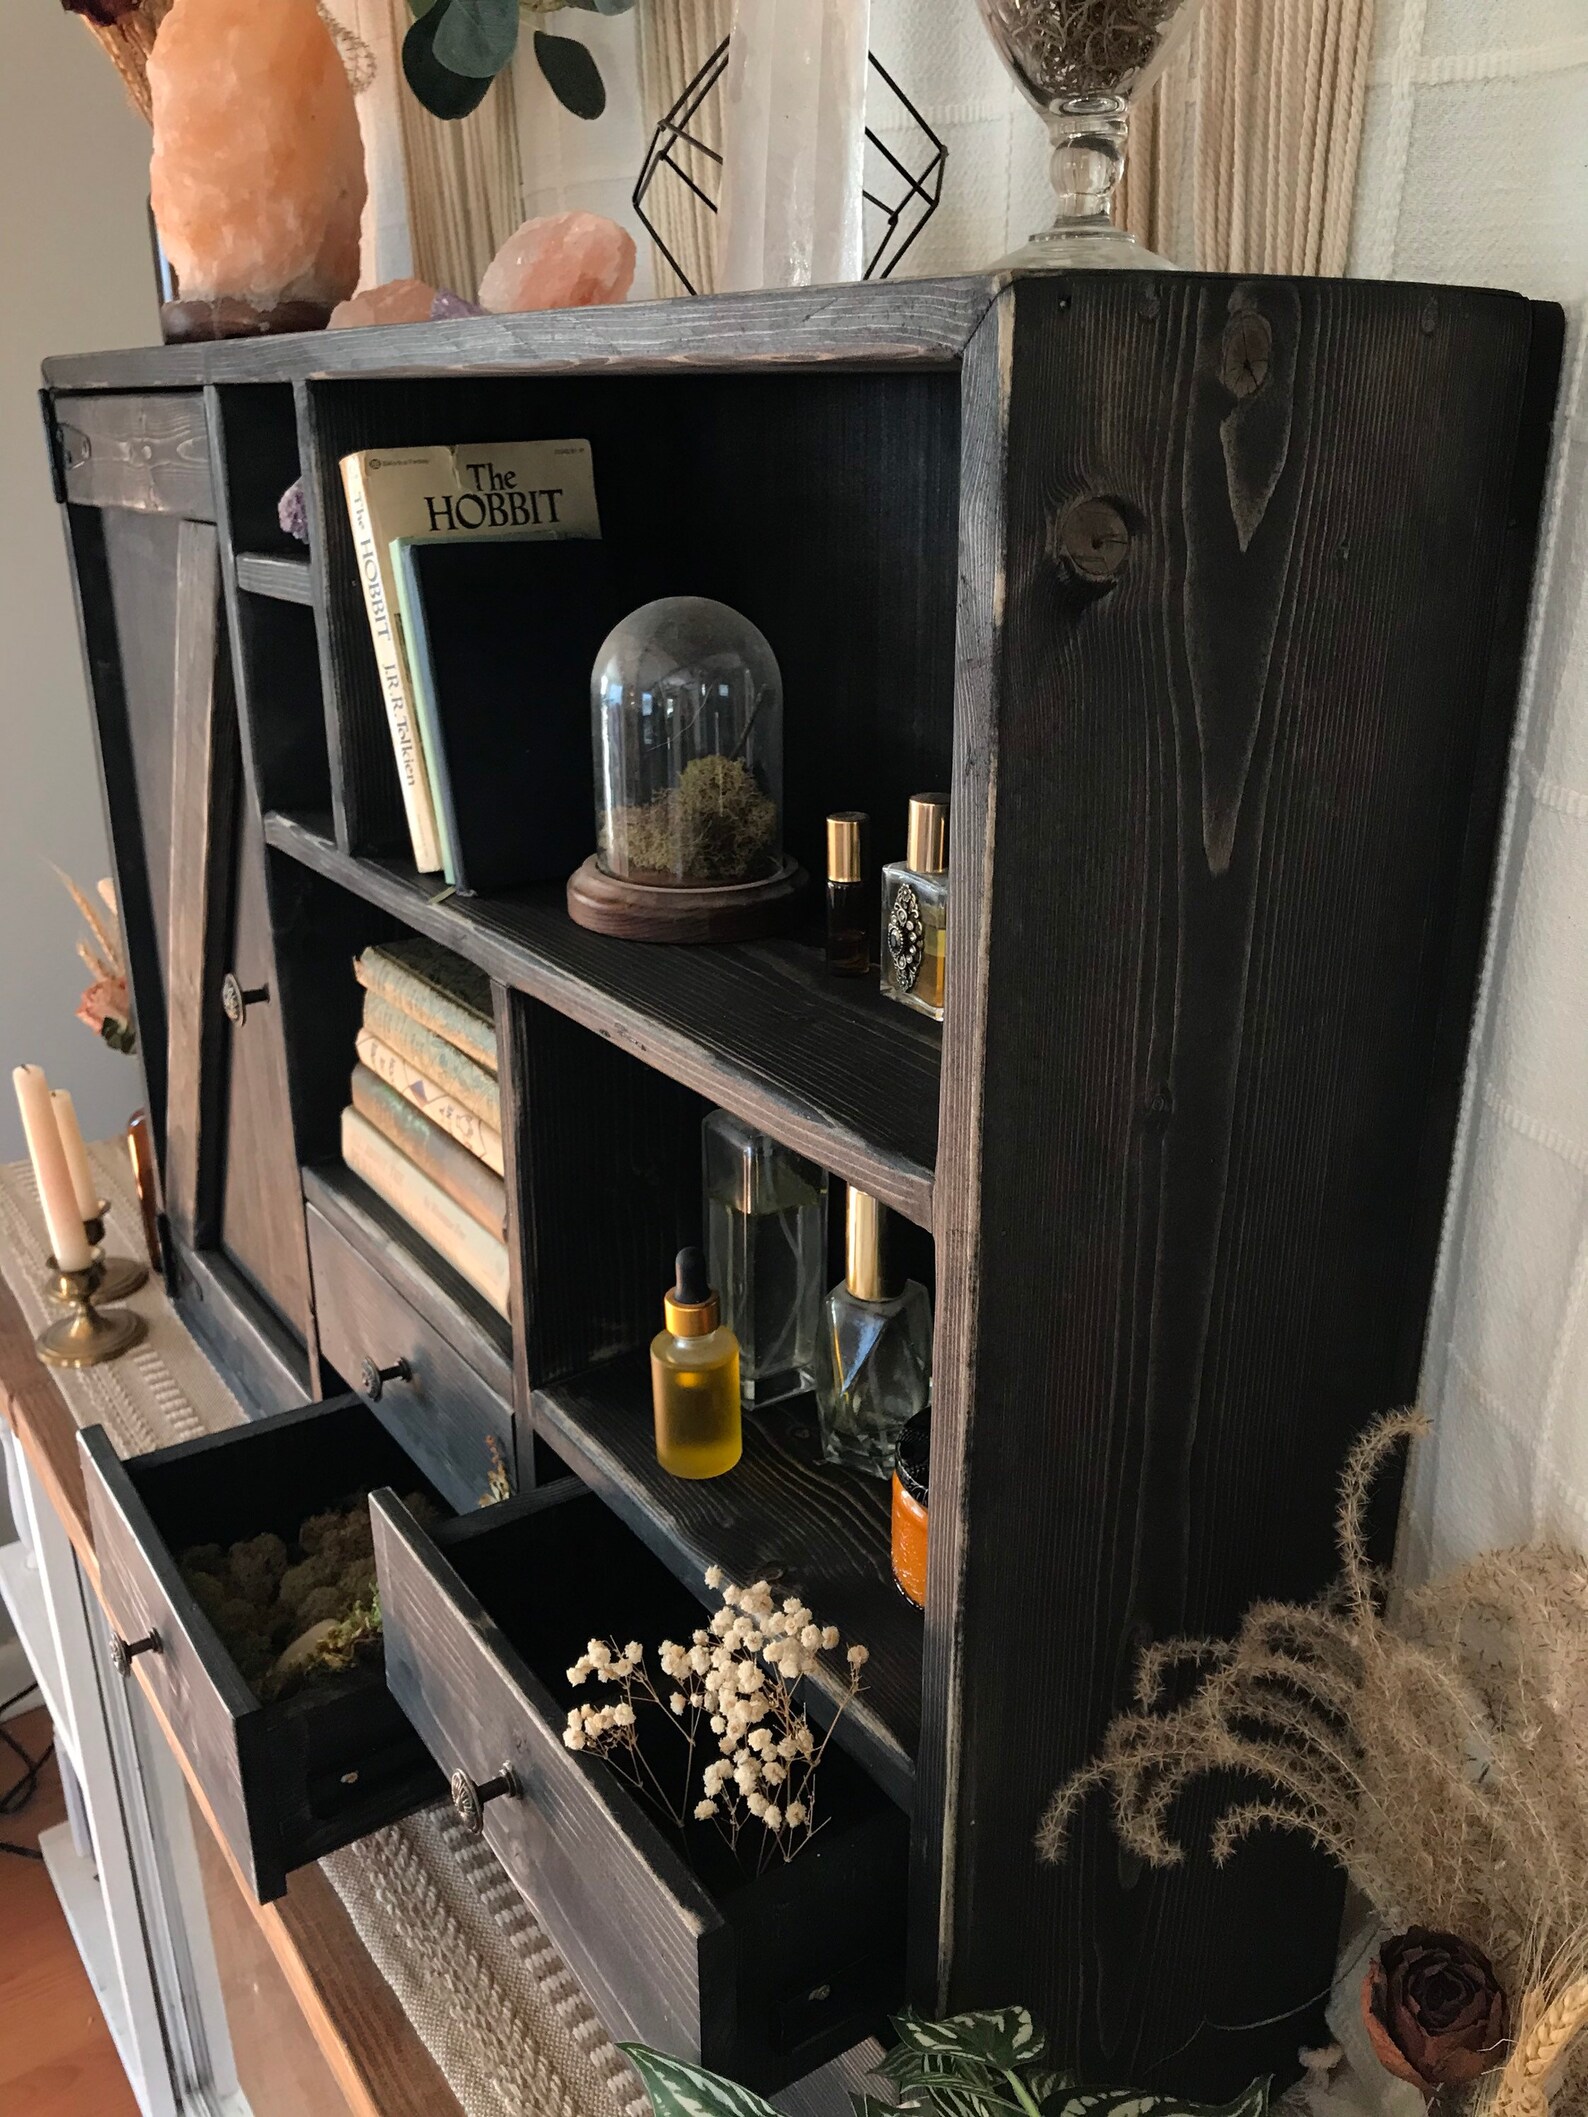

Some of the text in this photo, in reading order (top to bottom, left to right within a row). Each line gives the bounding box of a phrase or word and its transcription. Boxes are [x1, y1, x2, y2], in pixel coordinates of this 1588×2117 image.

[466, 463, 517, 492] The
[424, 488, 563, 531] HOBBIT
[353, 491, 392, 642] The HOBBIT
